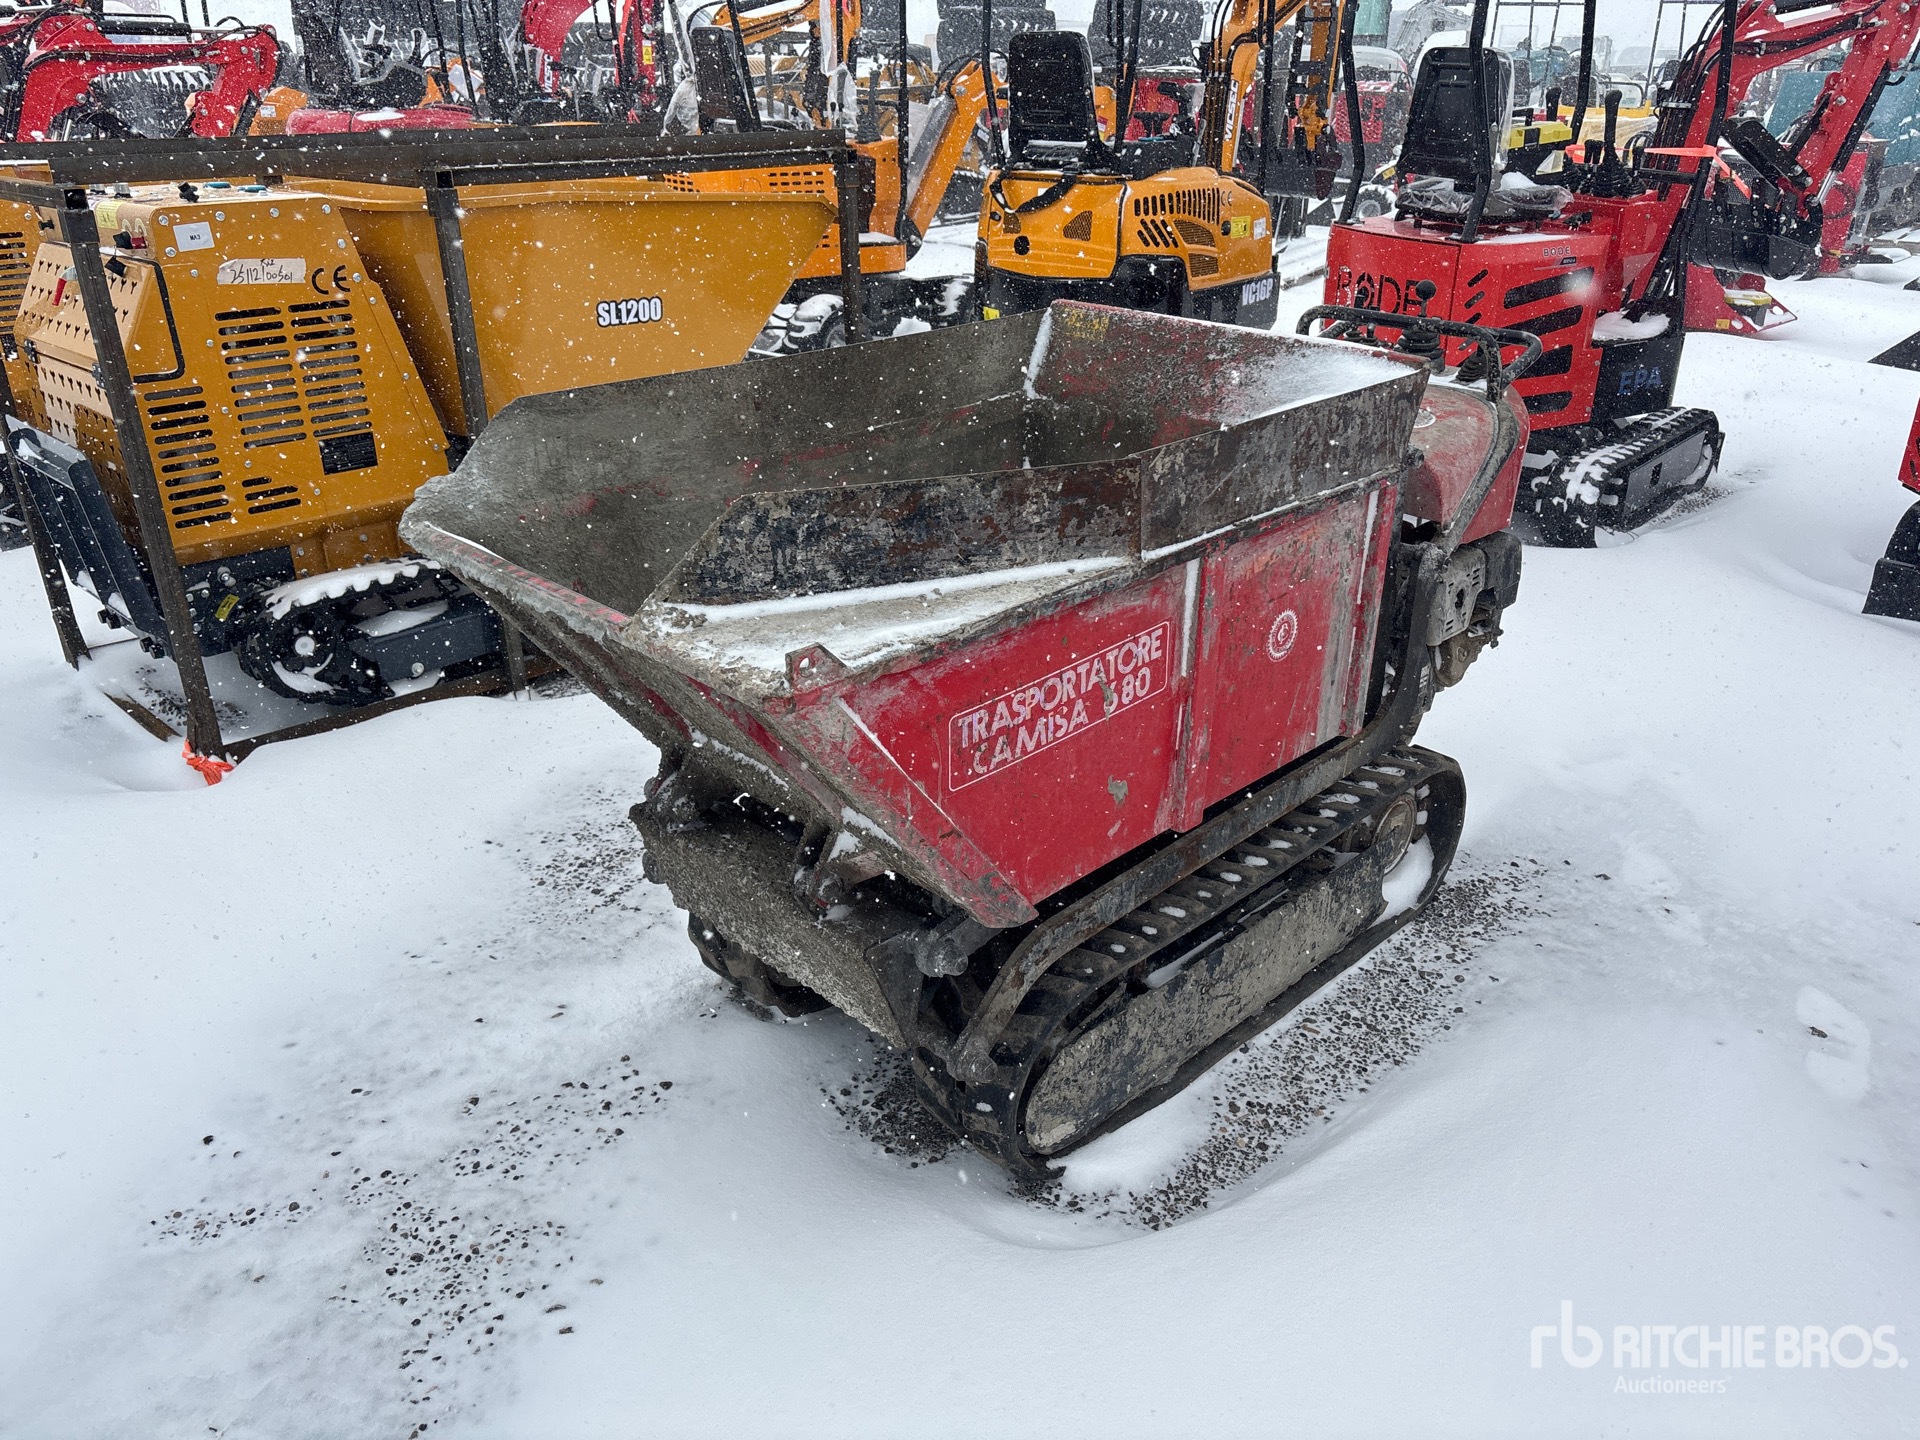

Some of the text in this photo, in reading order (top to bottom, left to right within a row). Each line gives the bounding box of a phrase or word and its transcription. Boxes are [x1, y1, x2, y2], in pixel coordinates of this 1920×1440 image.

[1224, 80, 1239, 140] VICSEC
[1544, 246, 1571, 257] BODE
[312, 264, 351, 295] CE
[1242, 278, 1274, 306] VC16P
[597, 297, 662, 327] SL1200
[1619, 367, 1663, 395] EPA
[958, 627, 1163, 749] TRASPORTATORE
[973, 698, 1089, 774] CAMISA
